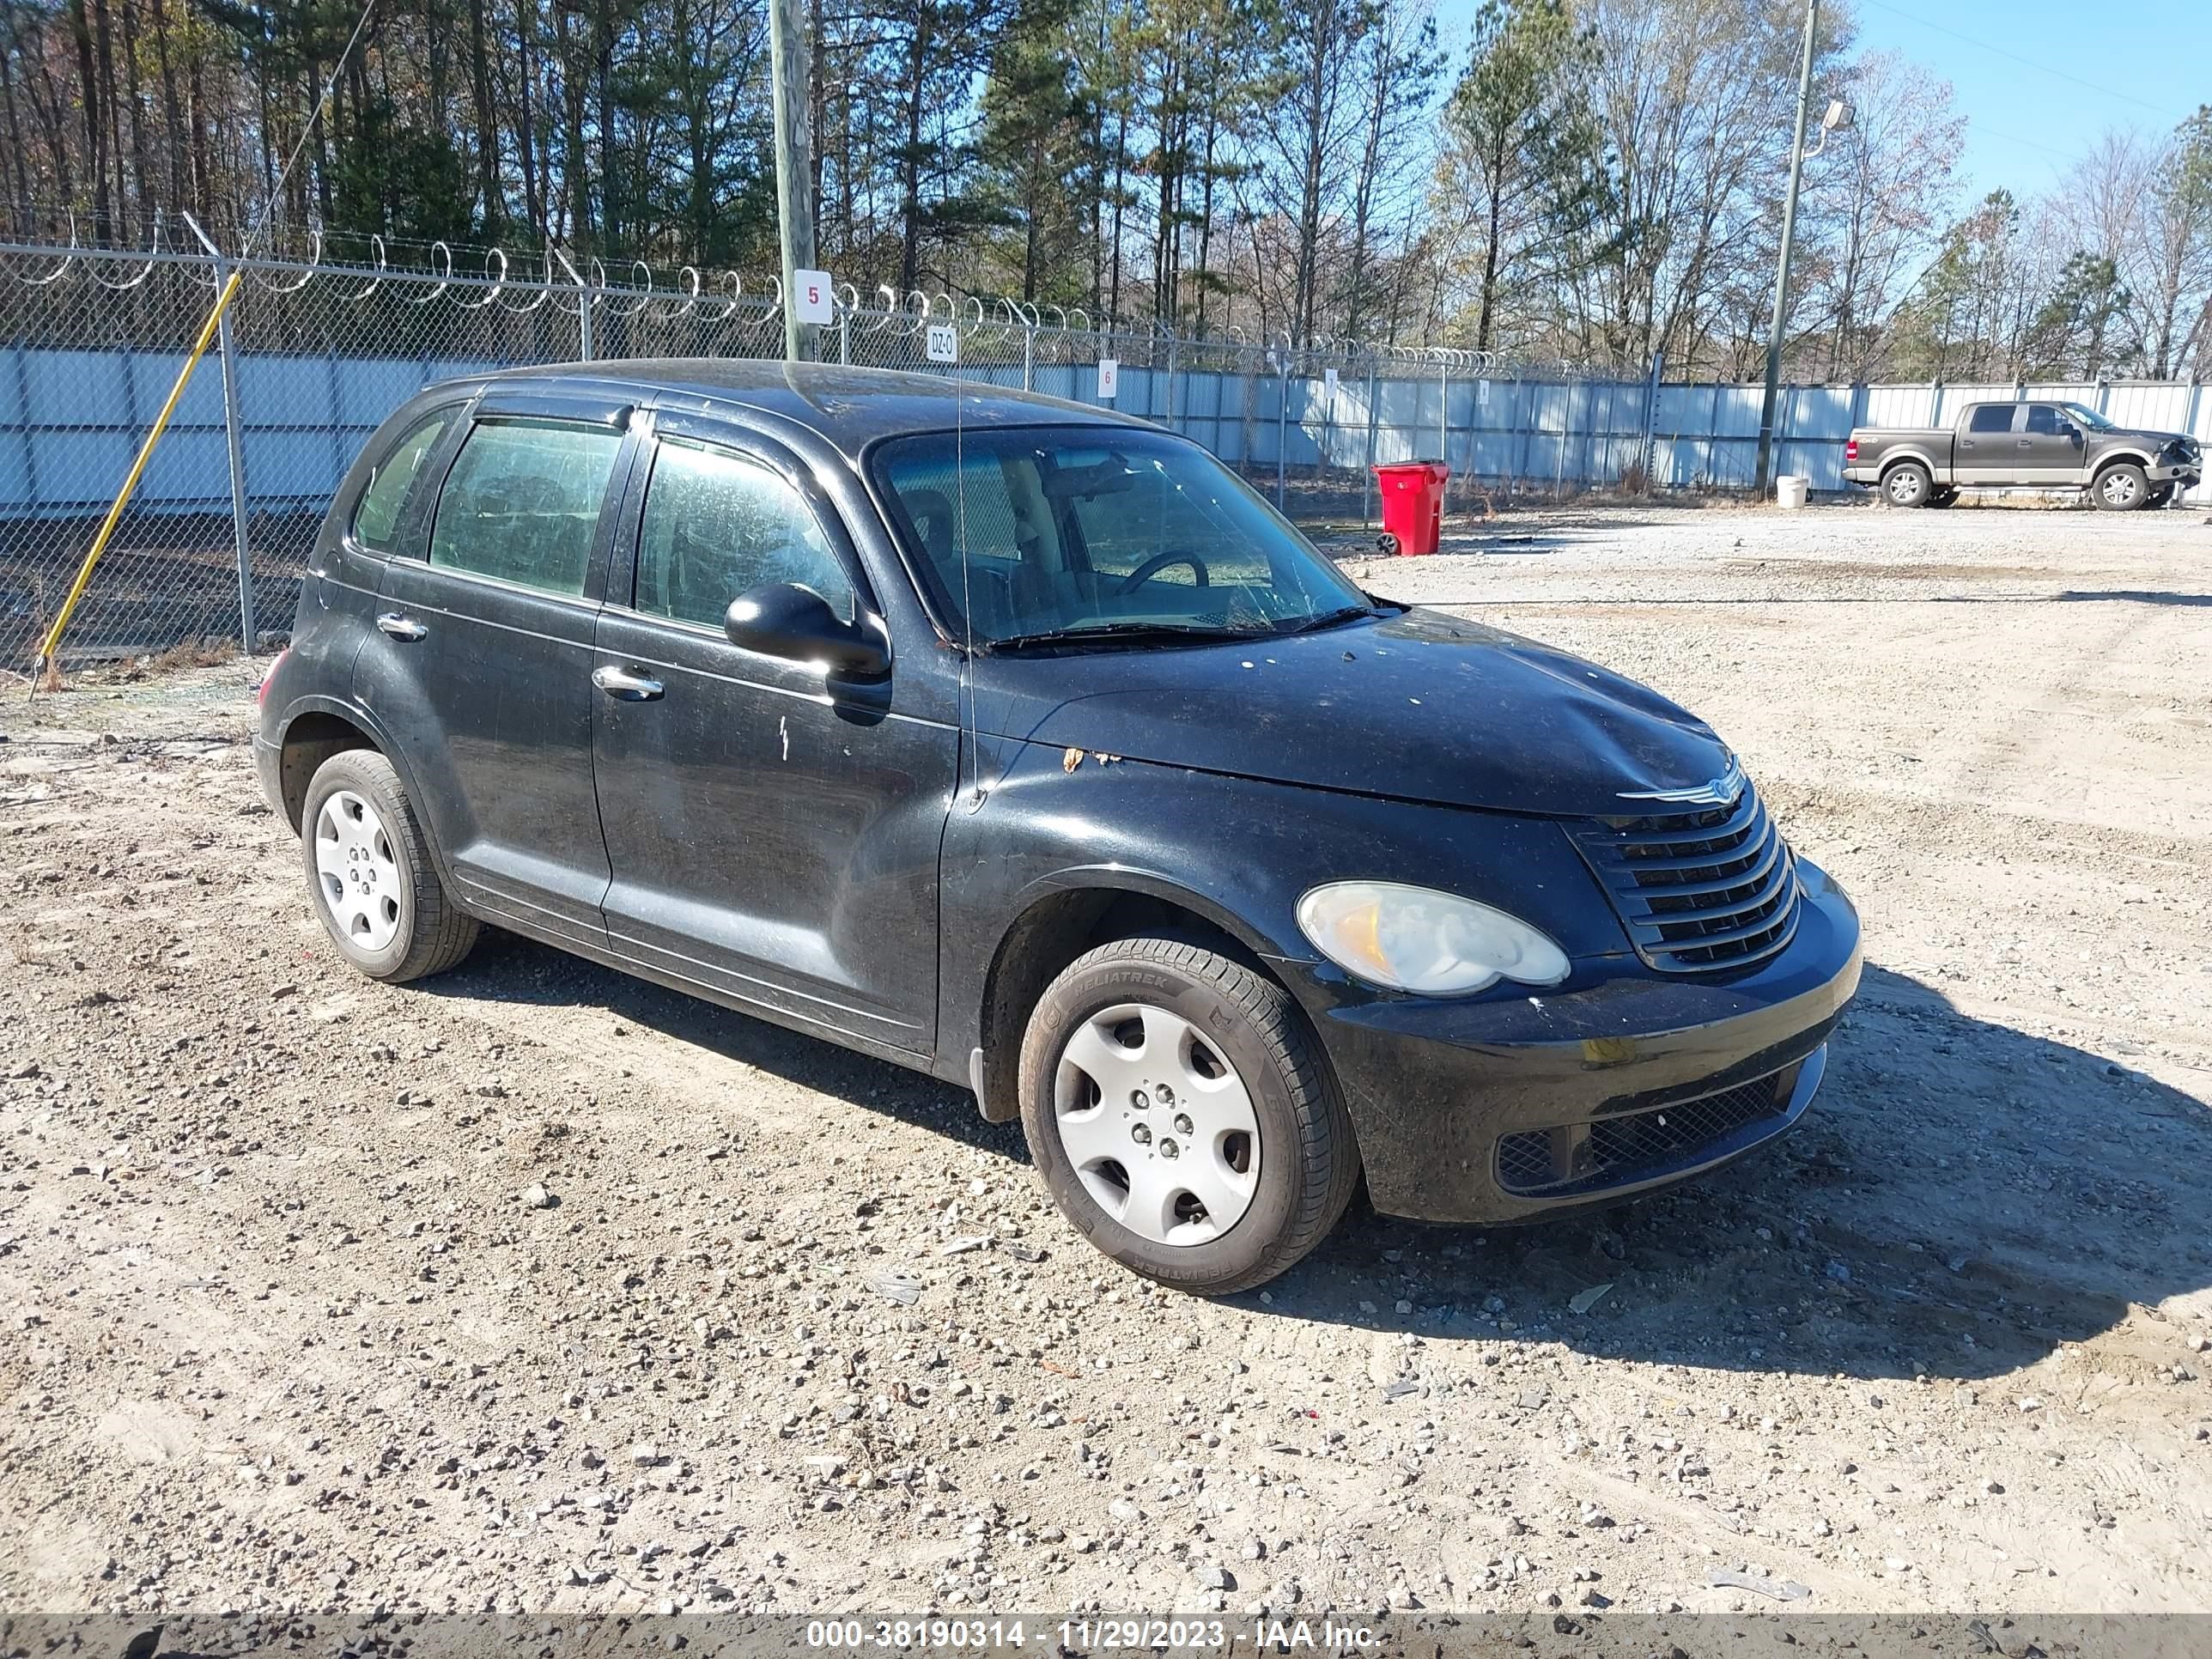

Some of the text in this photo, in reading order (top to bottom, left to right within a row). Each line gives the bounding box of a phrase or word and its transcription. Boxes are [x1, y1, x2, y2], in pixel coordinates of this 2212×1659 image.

[808, 287, 819, 304] 5
[1105, 371, 1111, 385] 6
[1075, 970, 1167, 997] RELIATREK
